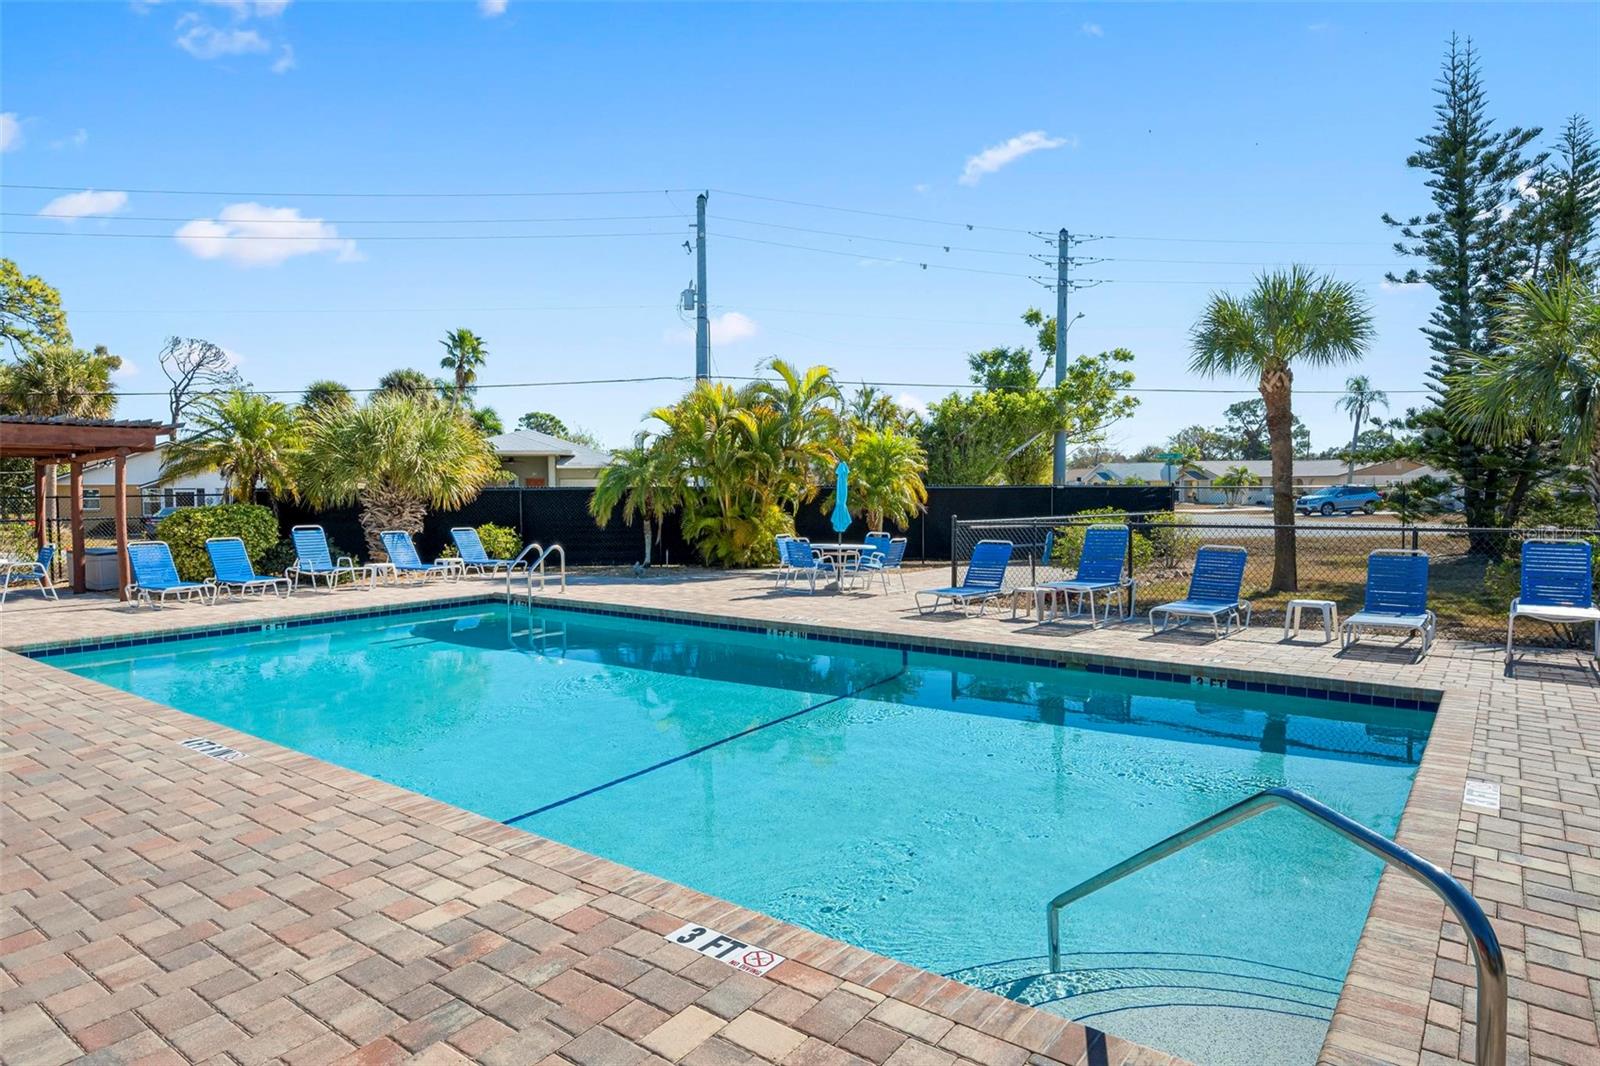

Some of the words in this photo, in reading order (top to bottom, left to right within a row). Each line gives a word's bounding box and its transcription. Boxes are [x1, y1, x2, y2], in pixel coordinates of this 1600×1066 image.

[676, 927, 707, 944] 3
[698, 935, 748, 959] FT
[728, 959, 741, 968] NO
[738, 964, 763, 976] DIVING
